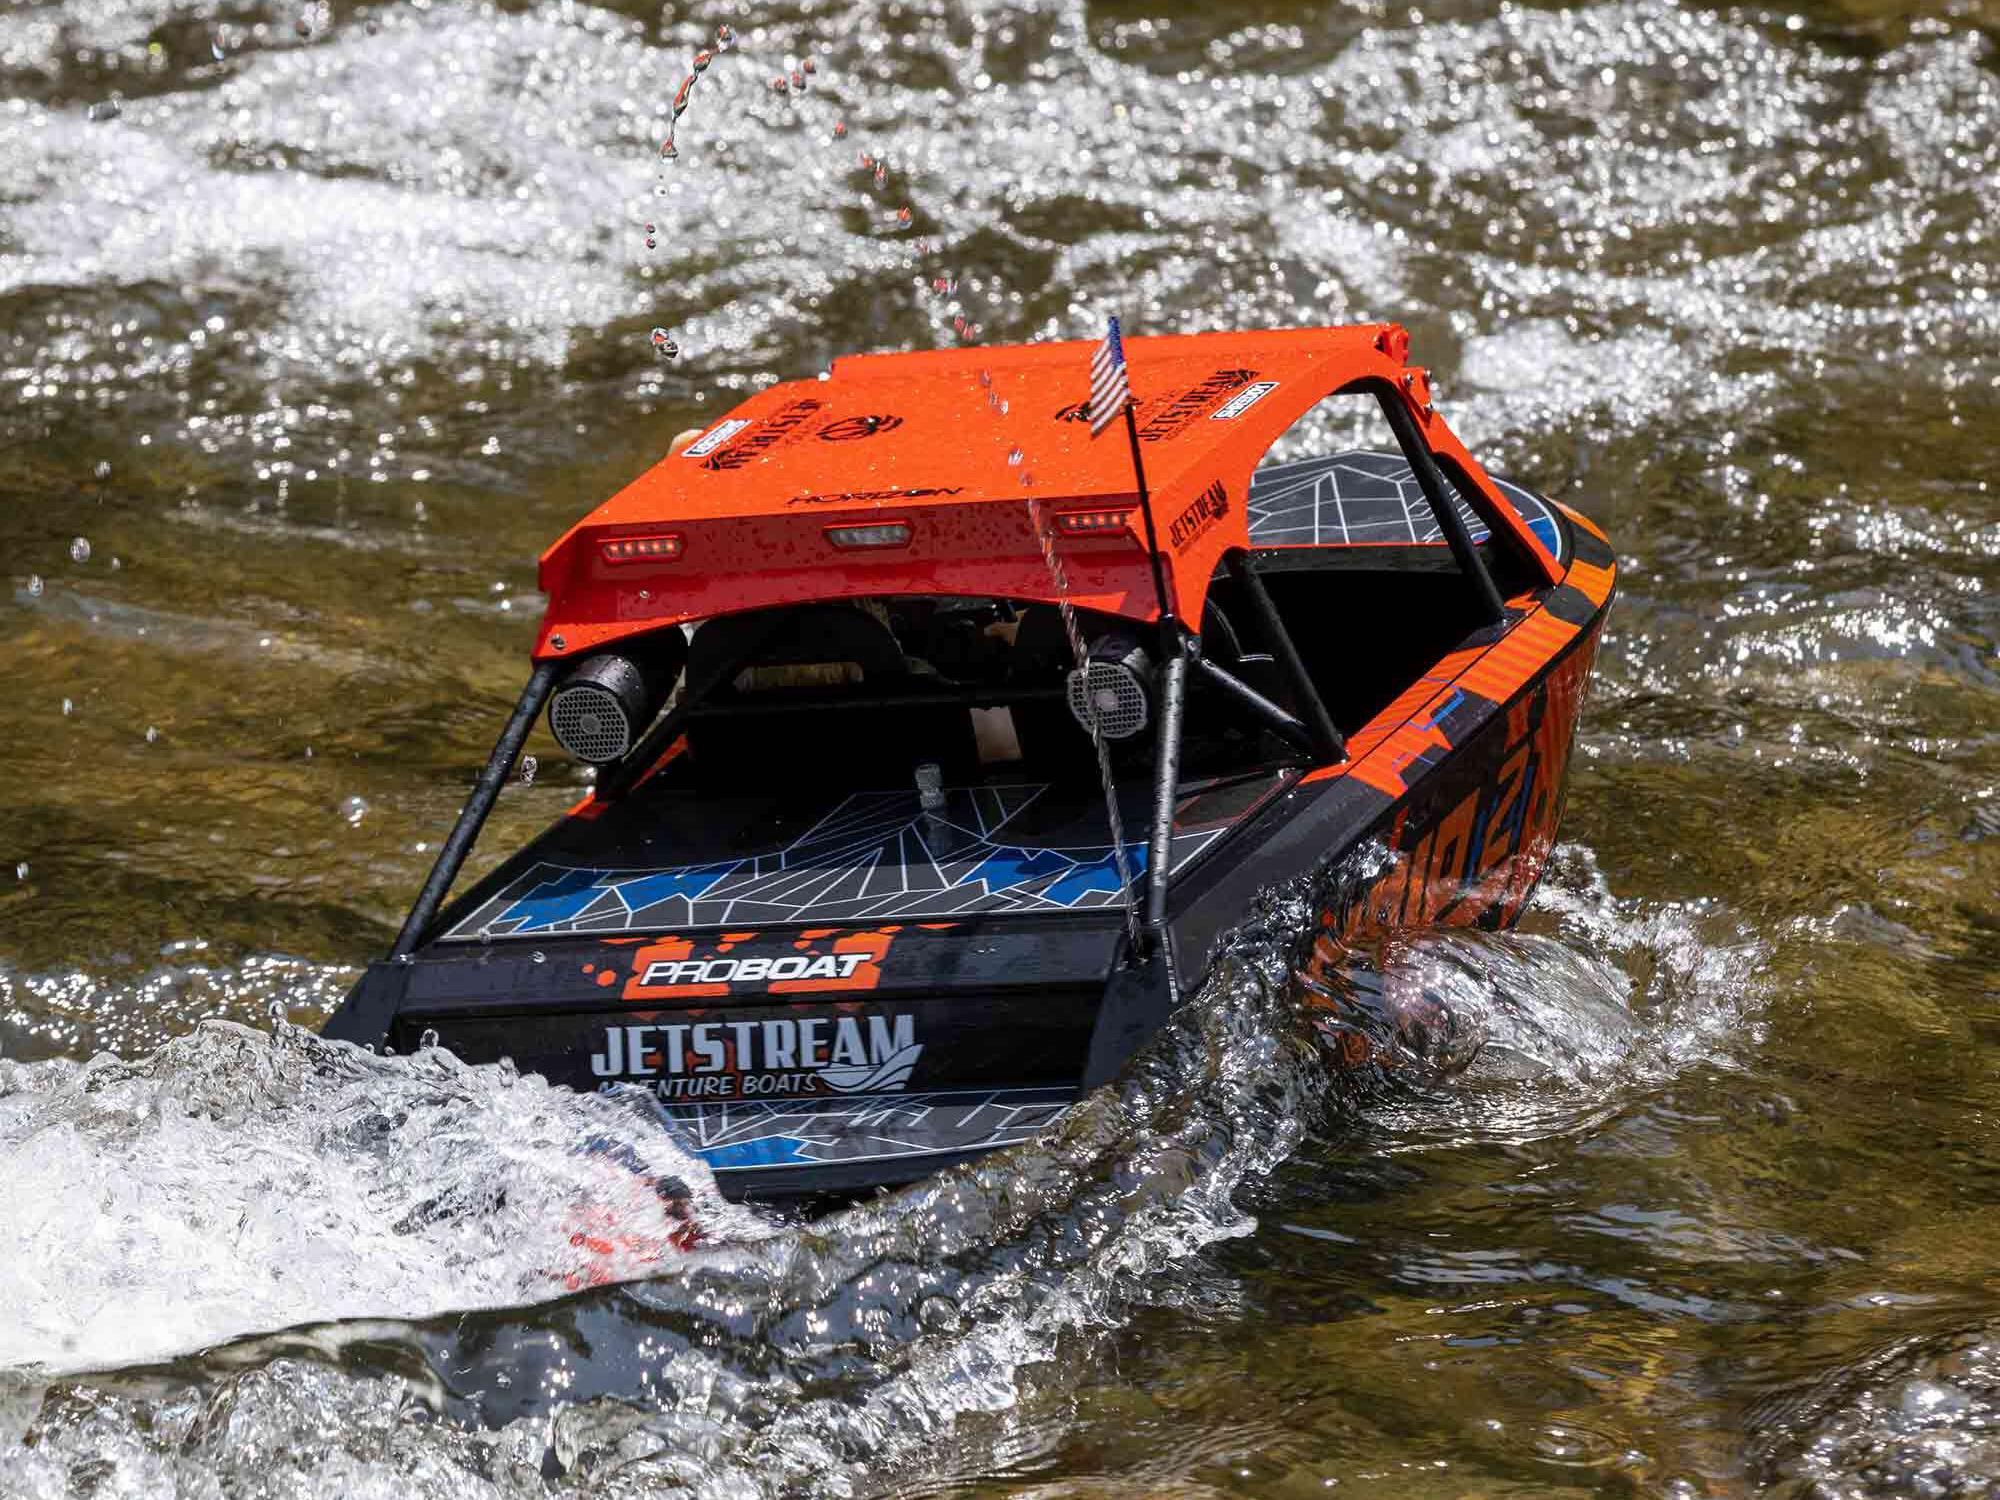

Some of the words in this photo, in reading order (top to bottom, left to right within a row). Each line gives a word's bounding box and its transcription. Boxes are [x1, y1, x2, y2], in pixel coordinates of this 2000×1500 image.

[1168, 478, 1227, 549] JETSTREAM
[639, 953, 872, 986] PROBOAT
[591, 1013, 915, 1077] JETSTREAM
[742, 1072, 818, 1095] BOATS
